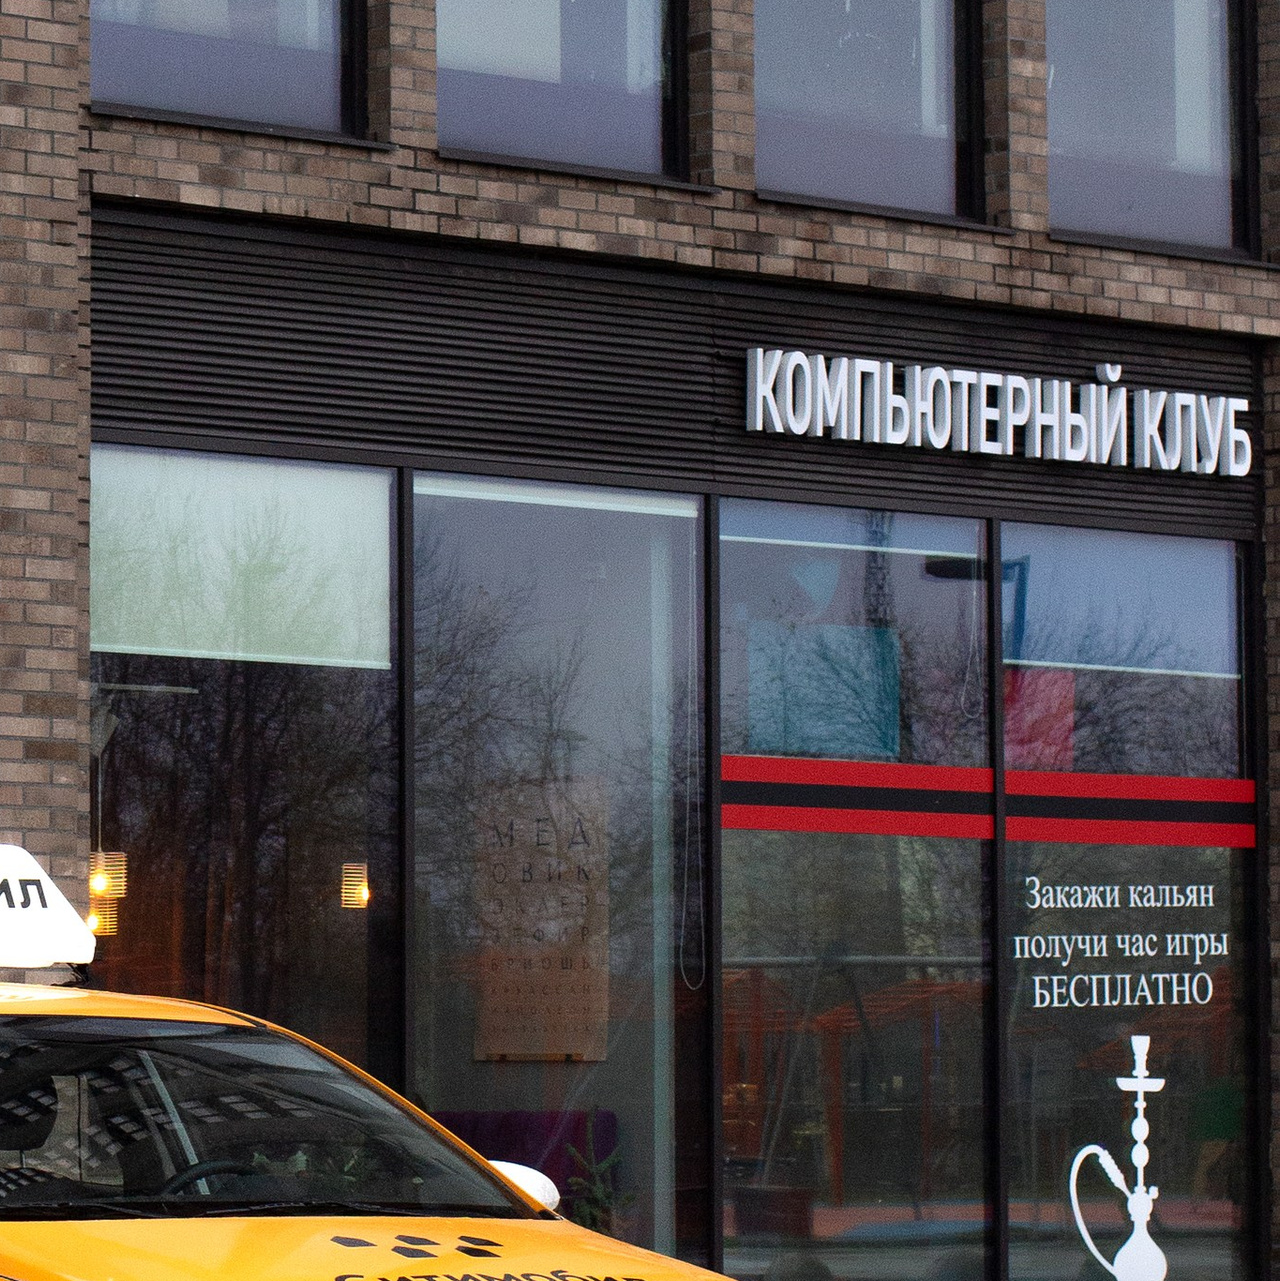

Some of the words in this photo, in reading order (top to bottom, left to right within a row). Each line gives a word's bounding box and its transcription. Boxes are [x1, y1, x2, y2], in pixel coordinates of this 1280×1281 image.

[746, 347, 1128, 468] КОМПЬЮТЕРНЫЙ
[1134, 389, 1253, 477] КЛУБ
[1024, 876, 1120, 909] Закажи
[1128, 882, 1215, 908] кальян
[1013, 934, 1108, 967] получи
[1115, 932, 1159, 957] час
[1165, 931, 1229, 964] игры
[1032, 972, 1214, 1010] БЕСПЛАТНО
